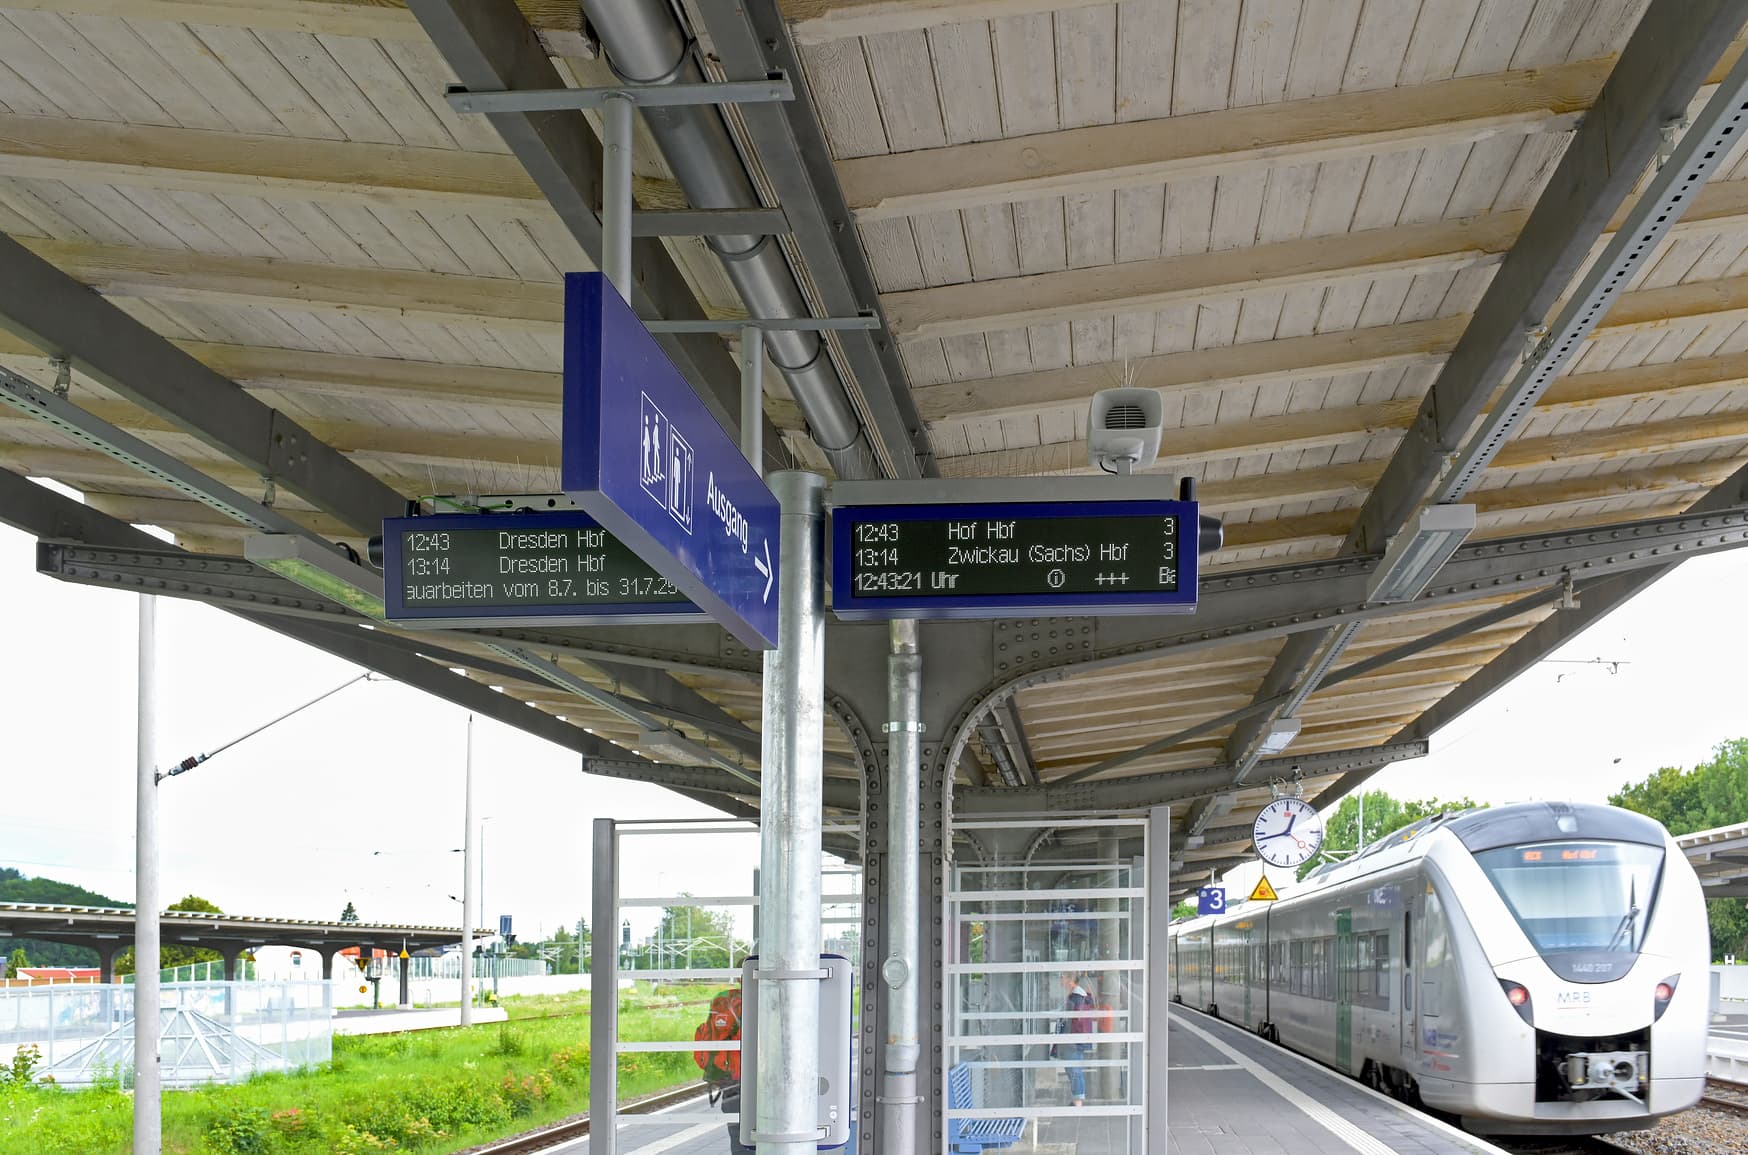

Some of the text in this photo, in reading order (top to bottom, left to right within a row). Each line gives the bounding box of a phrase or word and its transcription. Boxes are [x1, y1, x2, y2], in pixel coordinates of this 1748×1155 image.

[707, 471, 748, 554] Ausgang
[407, 529, 606, 552] 12:43 Dresden Hbf
[856, 517, 1174, 542] 12:43 Hof Hbf 3
[407, 554, 606, 576] 13:14 Dresden Hbf
[856, 542, 1174, 567] 13:14 Zwickau (Sachs) Hbf 3
[406, 581, 493, 600] auarbeiten
[503, 581, 539, 599] vom
[548, 579, 577, 598] 8.7.
[586, 578, 610, 597] bis
[854, 571, 921, 591] 12:43:21
[931, 570, 960, 590] Uhr
[1210, 889, 1223, 910] 3
[1557, 991, 1591, 1003] MRB
